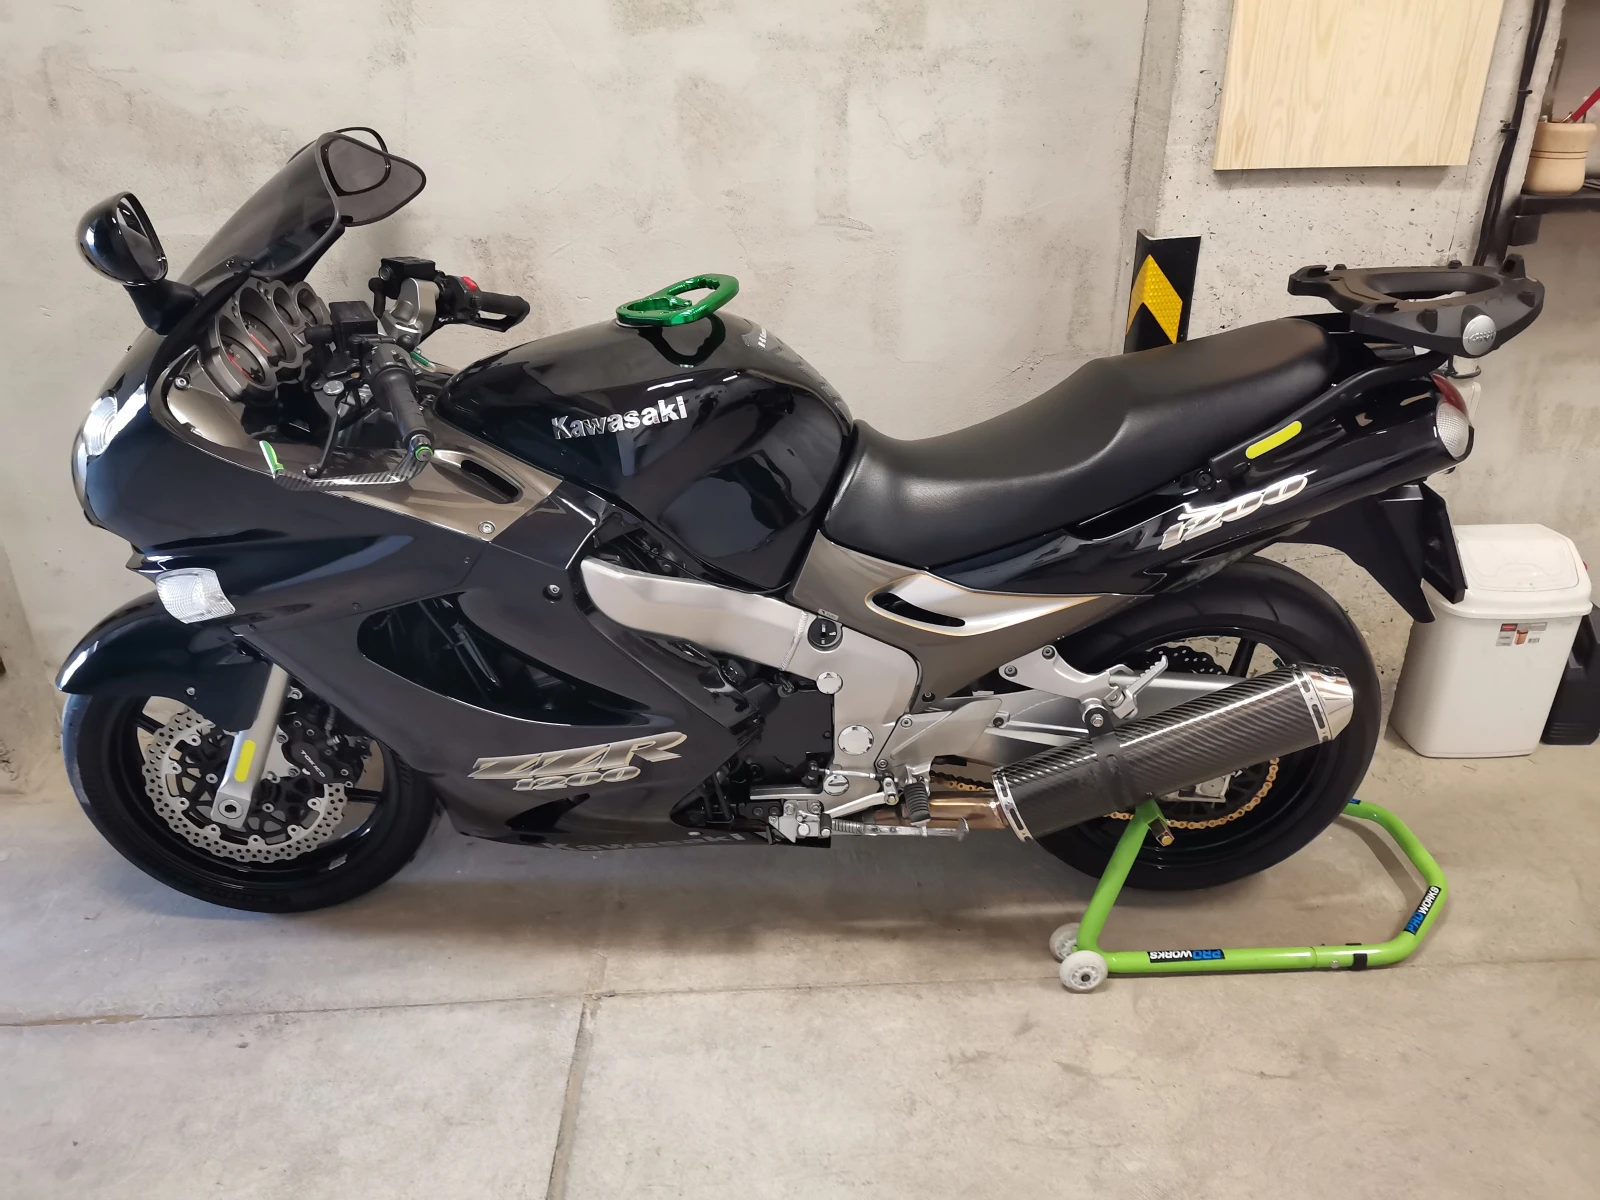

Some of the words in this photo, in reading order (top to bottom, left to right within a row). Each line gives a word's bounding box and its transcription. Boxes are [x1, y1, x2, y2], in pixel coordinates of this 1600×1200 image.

[551, 395, 688, 440] Kawasaki
[1158, 475, 1308, 551] 1200
[300, 749, 326, 778] TOKICO
[512, 766, 641, 791] 1200
[542, 832, 746, 851] Kawasaki
